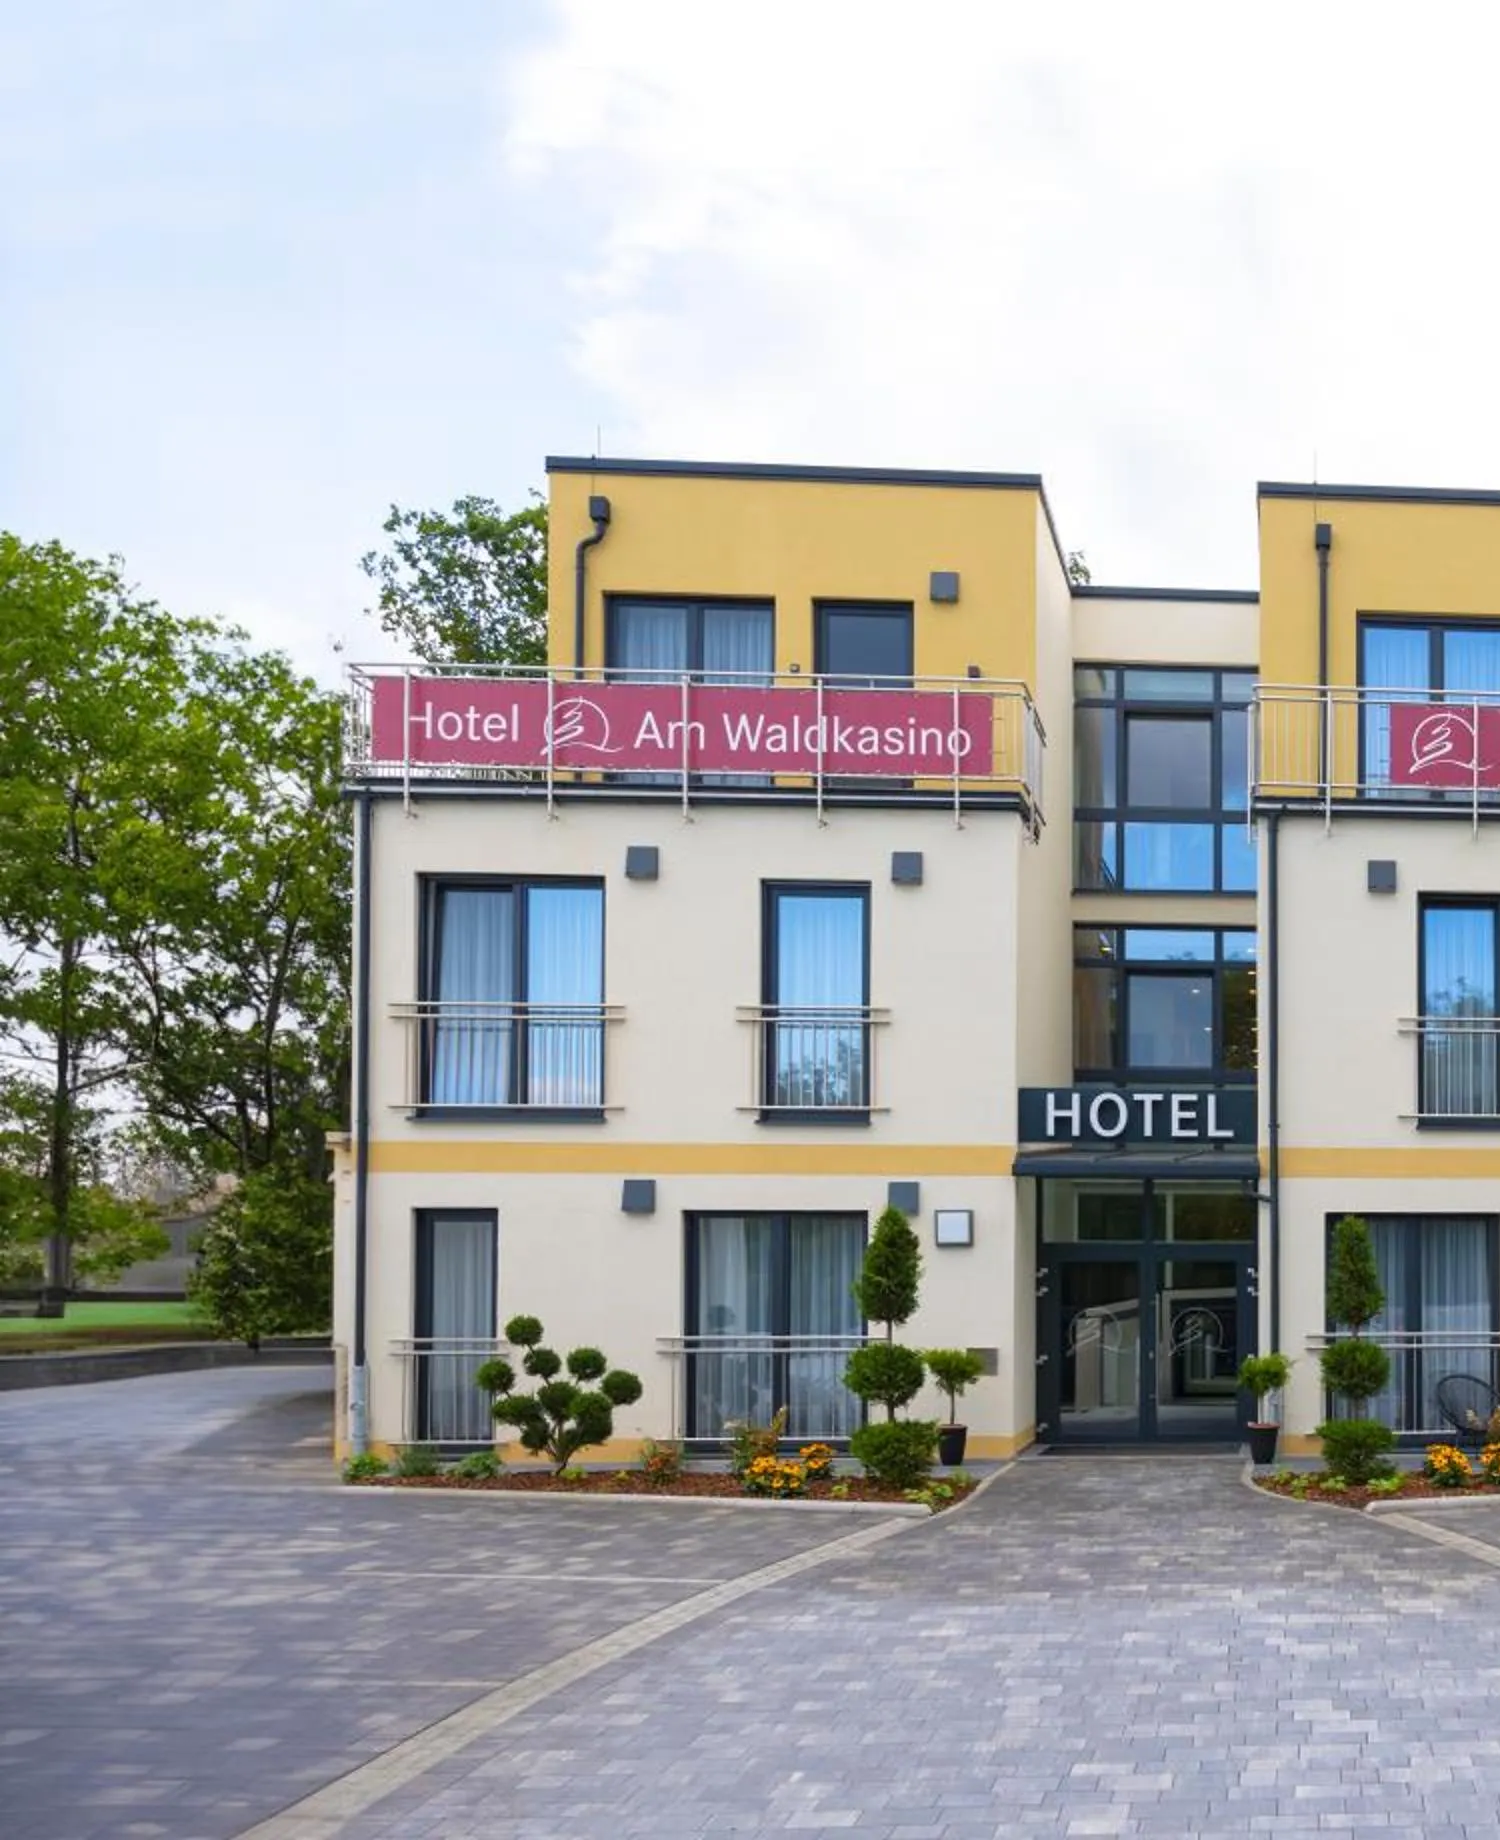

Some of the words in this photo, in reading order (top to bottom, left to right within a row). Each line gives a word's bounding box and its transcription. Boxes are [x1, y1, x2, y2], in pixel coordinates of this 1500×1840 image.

[404, 700, 519, 742] Hotel
[633, 711, 706, 751] Am
[722, 712, 972, 758] Waldkasino
[1045, 1091, 1235, 1138] HOTEL
